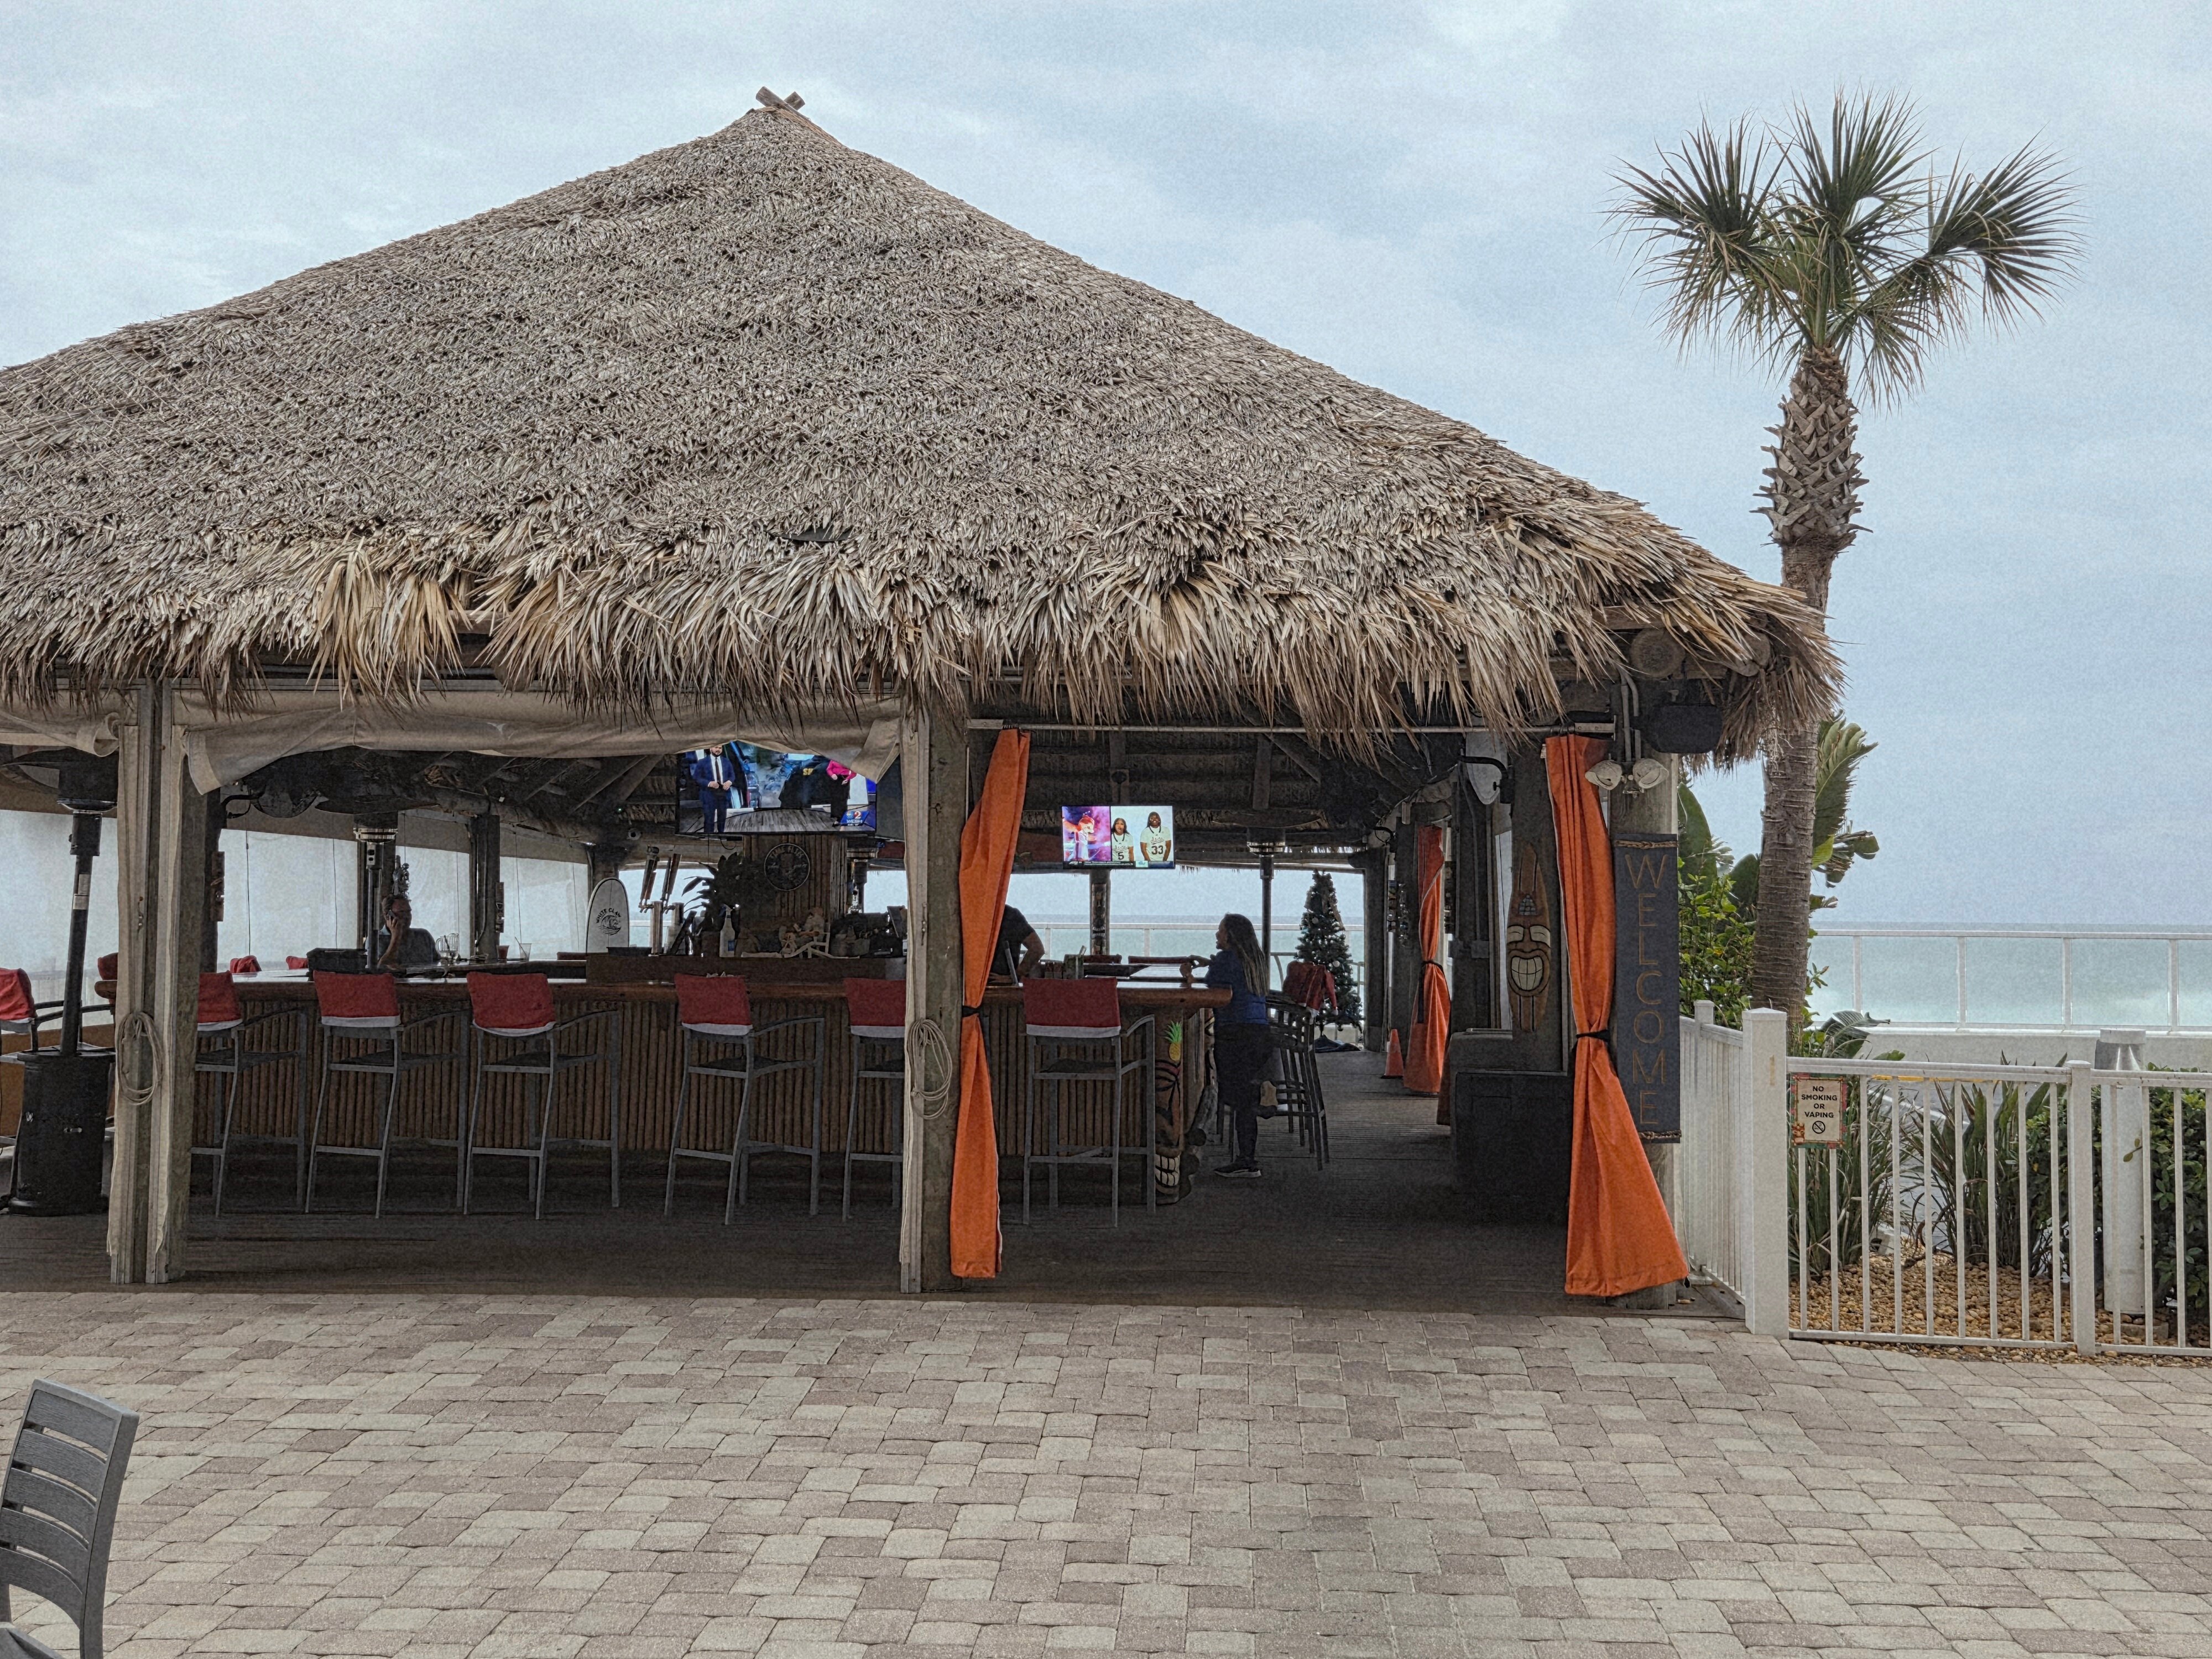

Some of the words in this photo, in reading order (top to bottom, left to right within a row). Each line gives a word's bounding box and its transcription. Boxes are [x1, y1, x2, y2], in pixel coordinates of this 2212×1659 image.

[1118, 852, 1124, 860] 5
[1151, 845, 1164, 854] 33
[596, 908, 608, 924] WHITE
[608, 907, 622, 917] CLAW
[1625, 854, 1669, 1125] WELCOME
